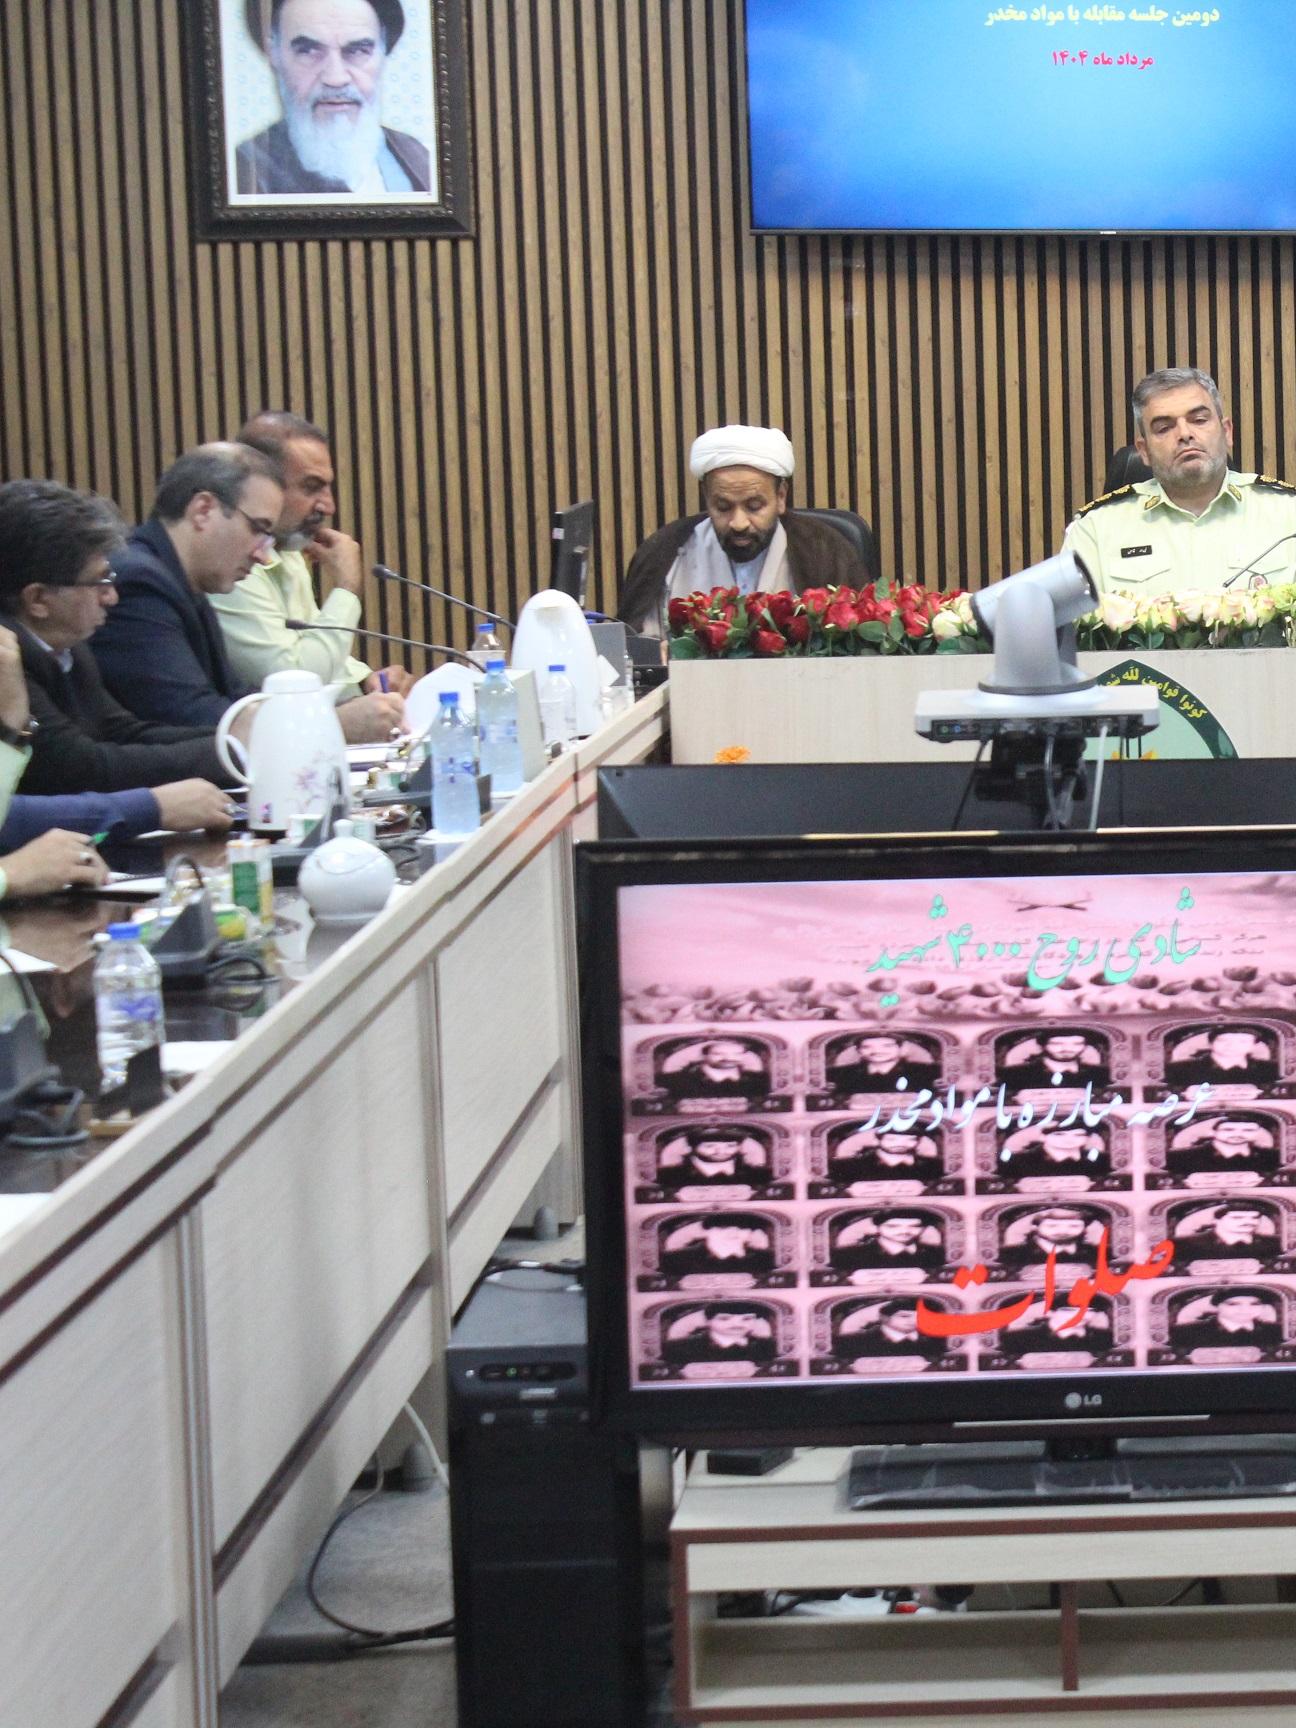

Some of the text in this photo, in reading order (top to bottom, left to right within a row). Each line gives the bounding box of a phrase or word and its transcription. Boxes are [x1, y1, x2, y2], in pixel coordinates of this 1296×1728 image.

[984, 3, 1220, 27] دومین جلسه مقابله با مواد مخدر
[1052, 49, 1154, 70] مرداد ماه ۱۴۰۴
[865, 894, 949, 1008] شهید
[1027, 931, 1099, 992] روح
[1103, 886, 1202, 985] شادی
[858, 1071, 1218, 1162] عرصه مبارزه با مواد مخدر
[917, 1226, 1175, 1337] صلوات
[1083, 1394, 1103, 1406] LG
